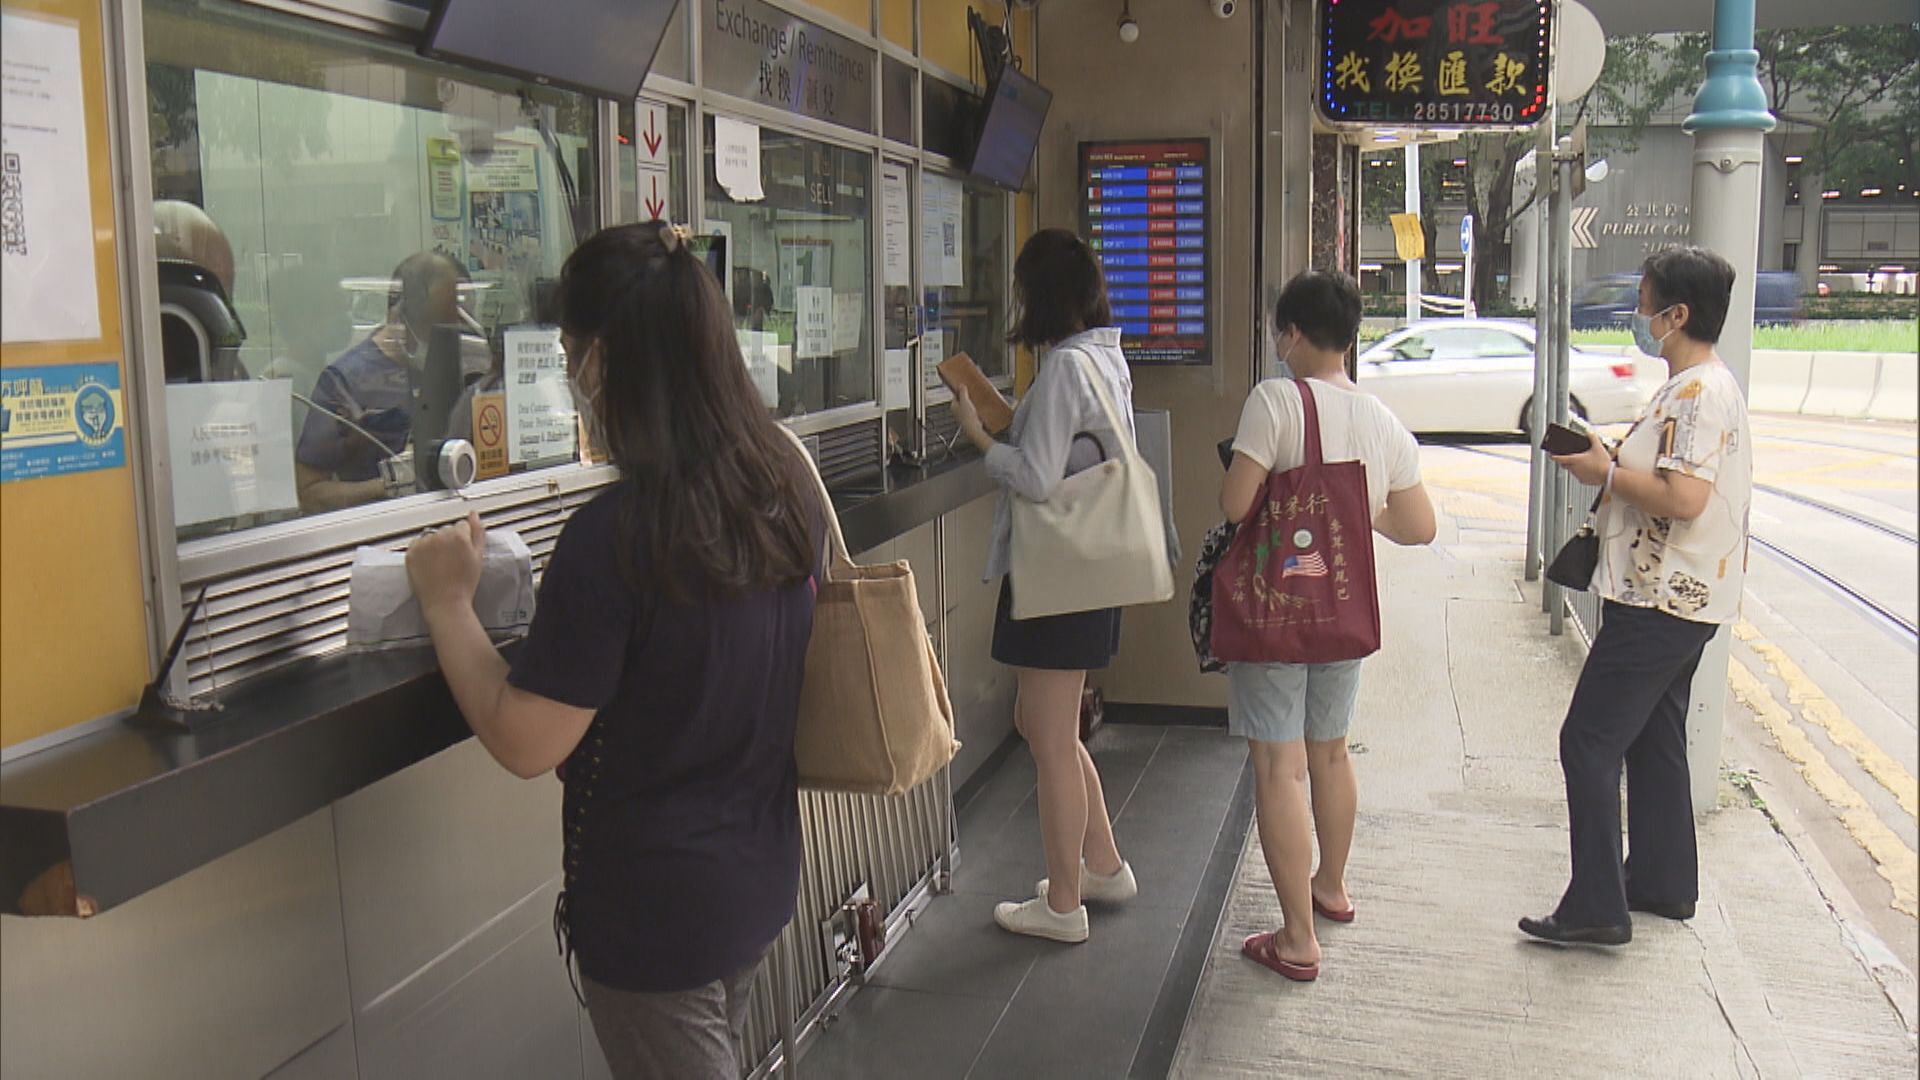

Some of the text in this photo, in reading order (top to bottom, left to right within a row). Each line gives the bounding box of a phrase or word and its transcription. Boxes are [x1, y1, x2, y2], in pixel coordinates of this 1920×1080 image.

[715, 0, 787, 59] Exchange
[799, 31, 864, 82] Remittance
[1366, 2, 1505, 44] 加旺
[758, 59, 791, 102] 找換
[1335, 50, 1527, 96] 找換匯款
[1413, 102, 1514, 121] 28517730
[1602, 222, 1657, 236] PUBLIC
